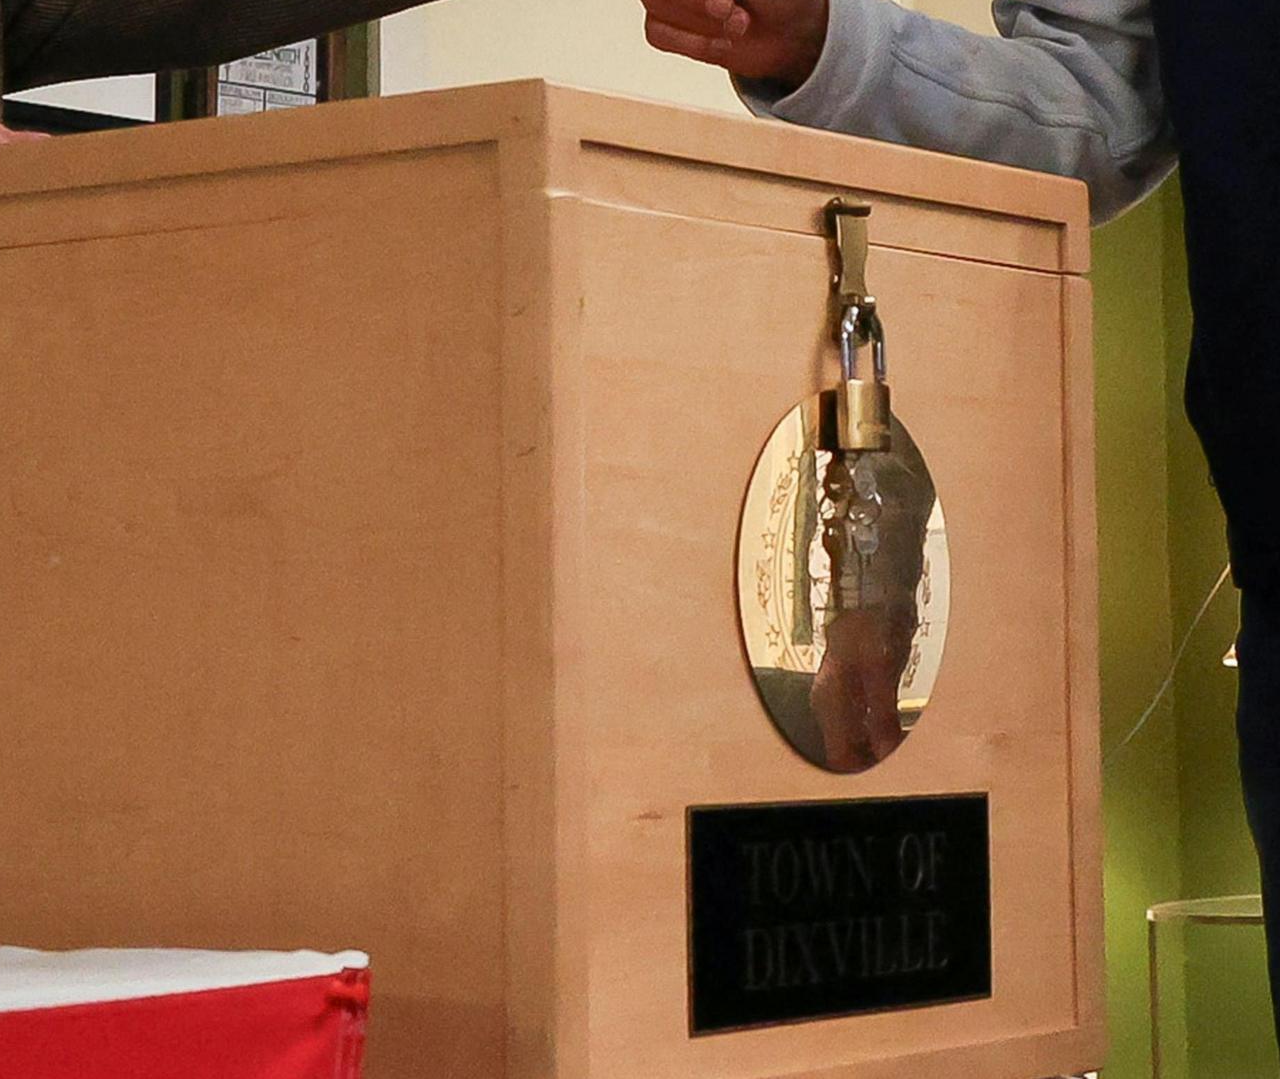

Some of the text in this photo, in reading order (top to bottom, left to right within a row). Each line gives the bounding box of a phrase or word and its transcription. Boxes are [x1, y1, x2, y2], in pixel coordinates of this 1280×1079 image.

[742, 832, 947, 904] TOWN OF
[742, 911, 948, 990] DIXVILLE
